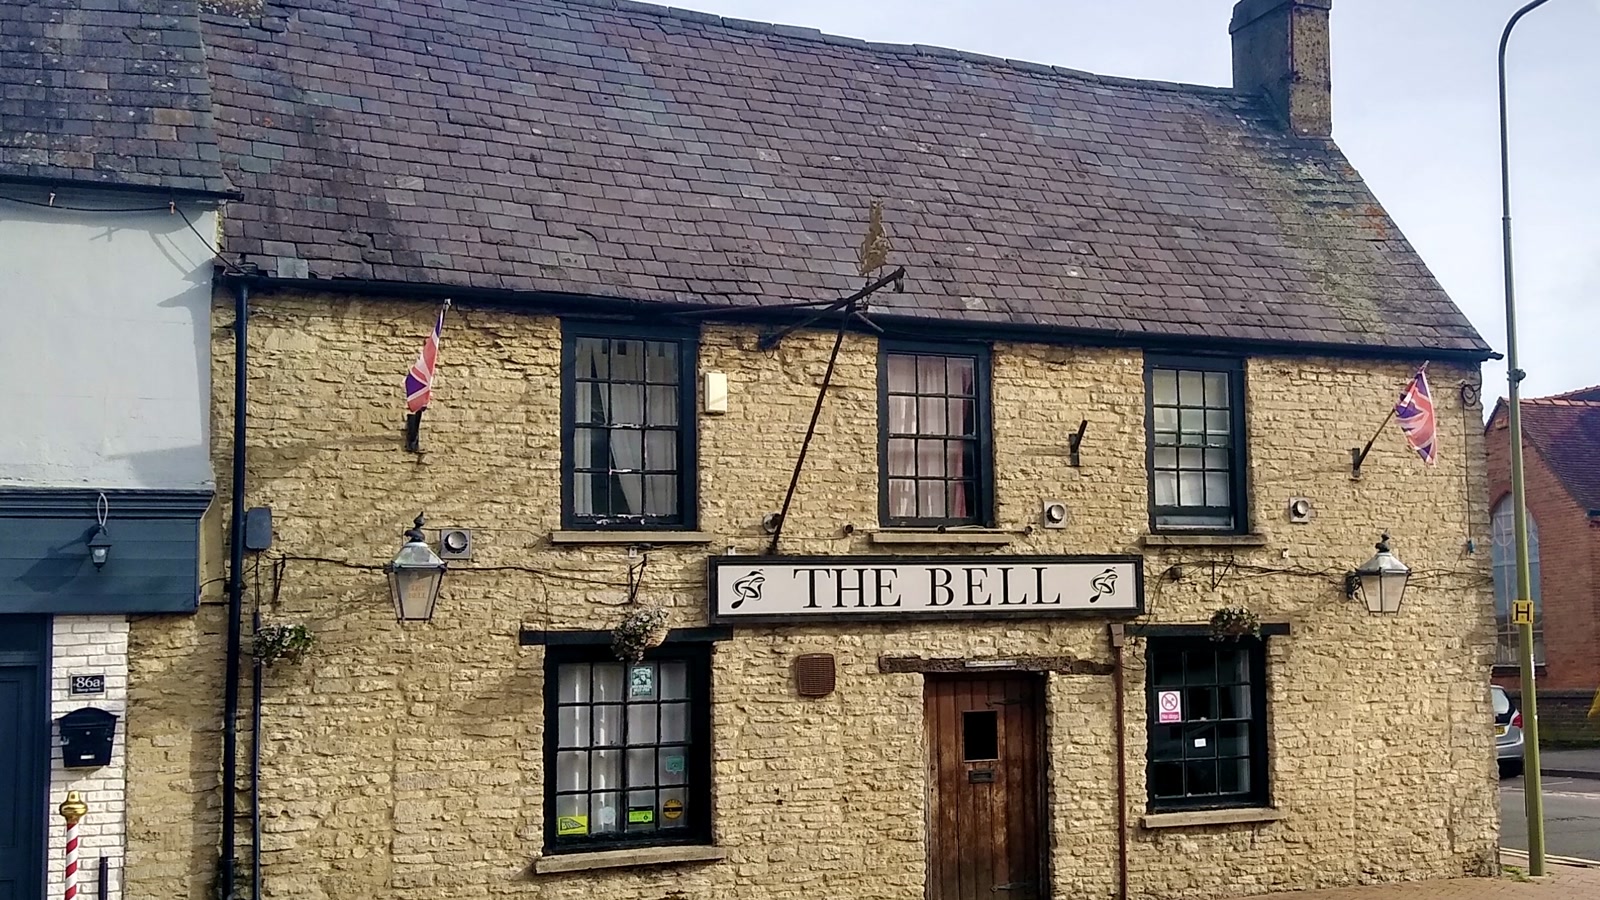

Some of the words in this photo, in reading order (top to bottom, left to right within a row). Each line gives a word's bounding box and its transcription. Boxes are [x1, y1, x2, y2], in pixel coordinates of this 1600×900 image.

[793, 568, 902, 609] THE
[925, 567, 1061, 606] BELL
[1515, 603, 1530, 621] H
[76, 676, 101, 688] 86a
